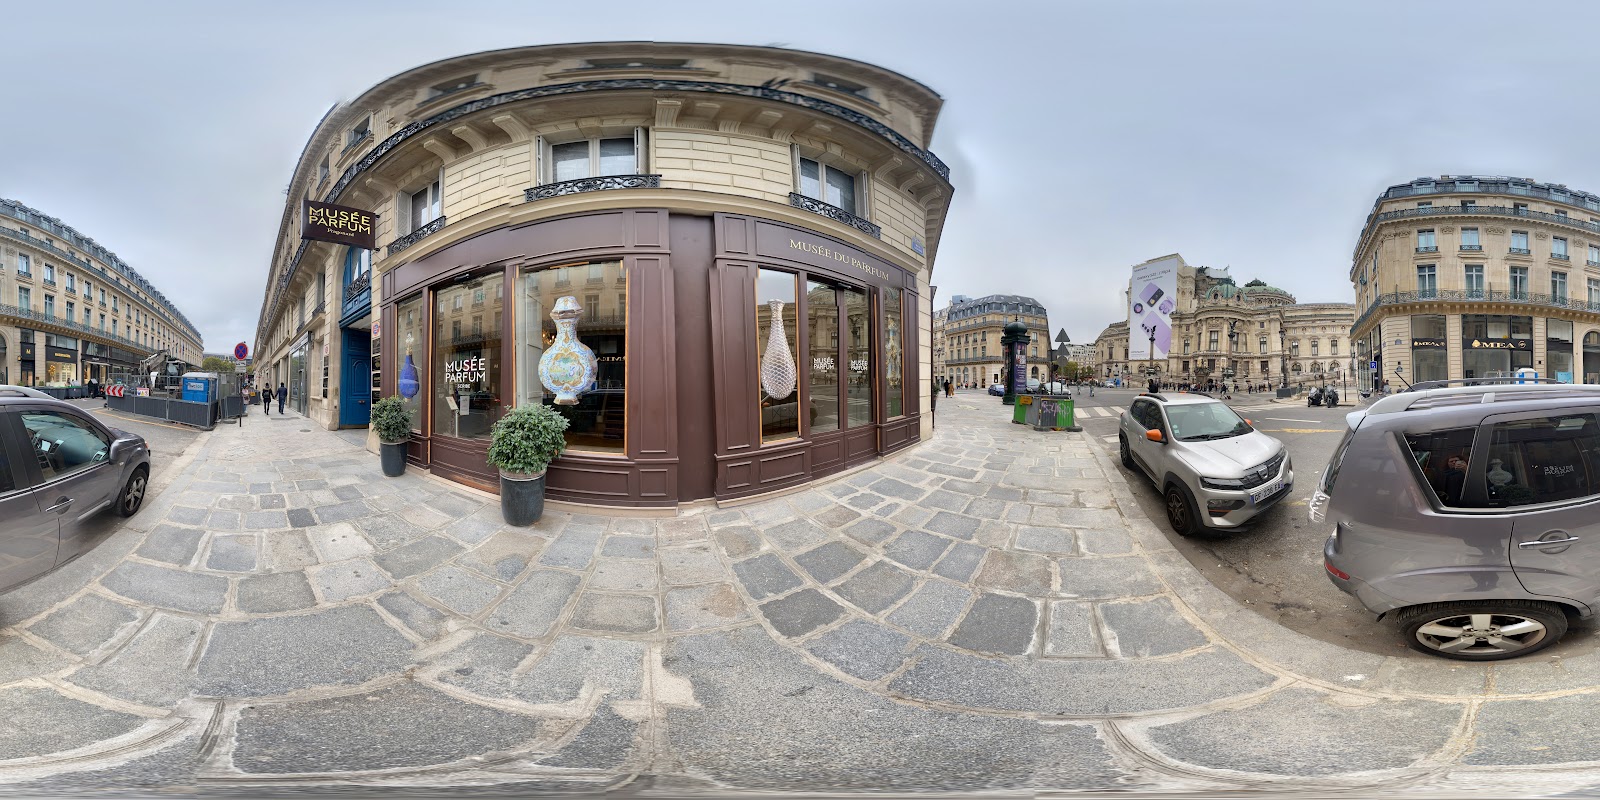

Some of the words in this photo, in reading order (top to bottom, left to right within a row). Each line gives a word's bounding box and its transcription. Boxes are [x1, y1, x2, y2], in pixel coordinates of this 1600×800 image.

[309, 206, 371, 226] MUSÉE
[309, 215, 371, 235] PARFUM
[789, 238, 832, 259] MUSÉE
[834, 251, 850, 264] DU
[445, 356, 486, 372] MUSÉE
[813, 356, 834, 364] MUSÉE
[445, 371, 486, 383] PARFUM
